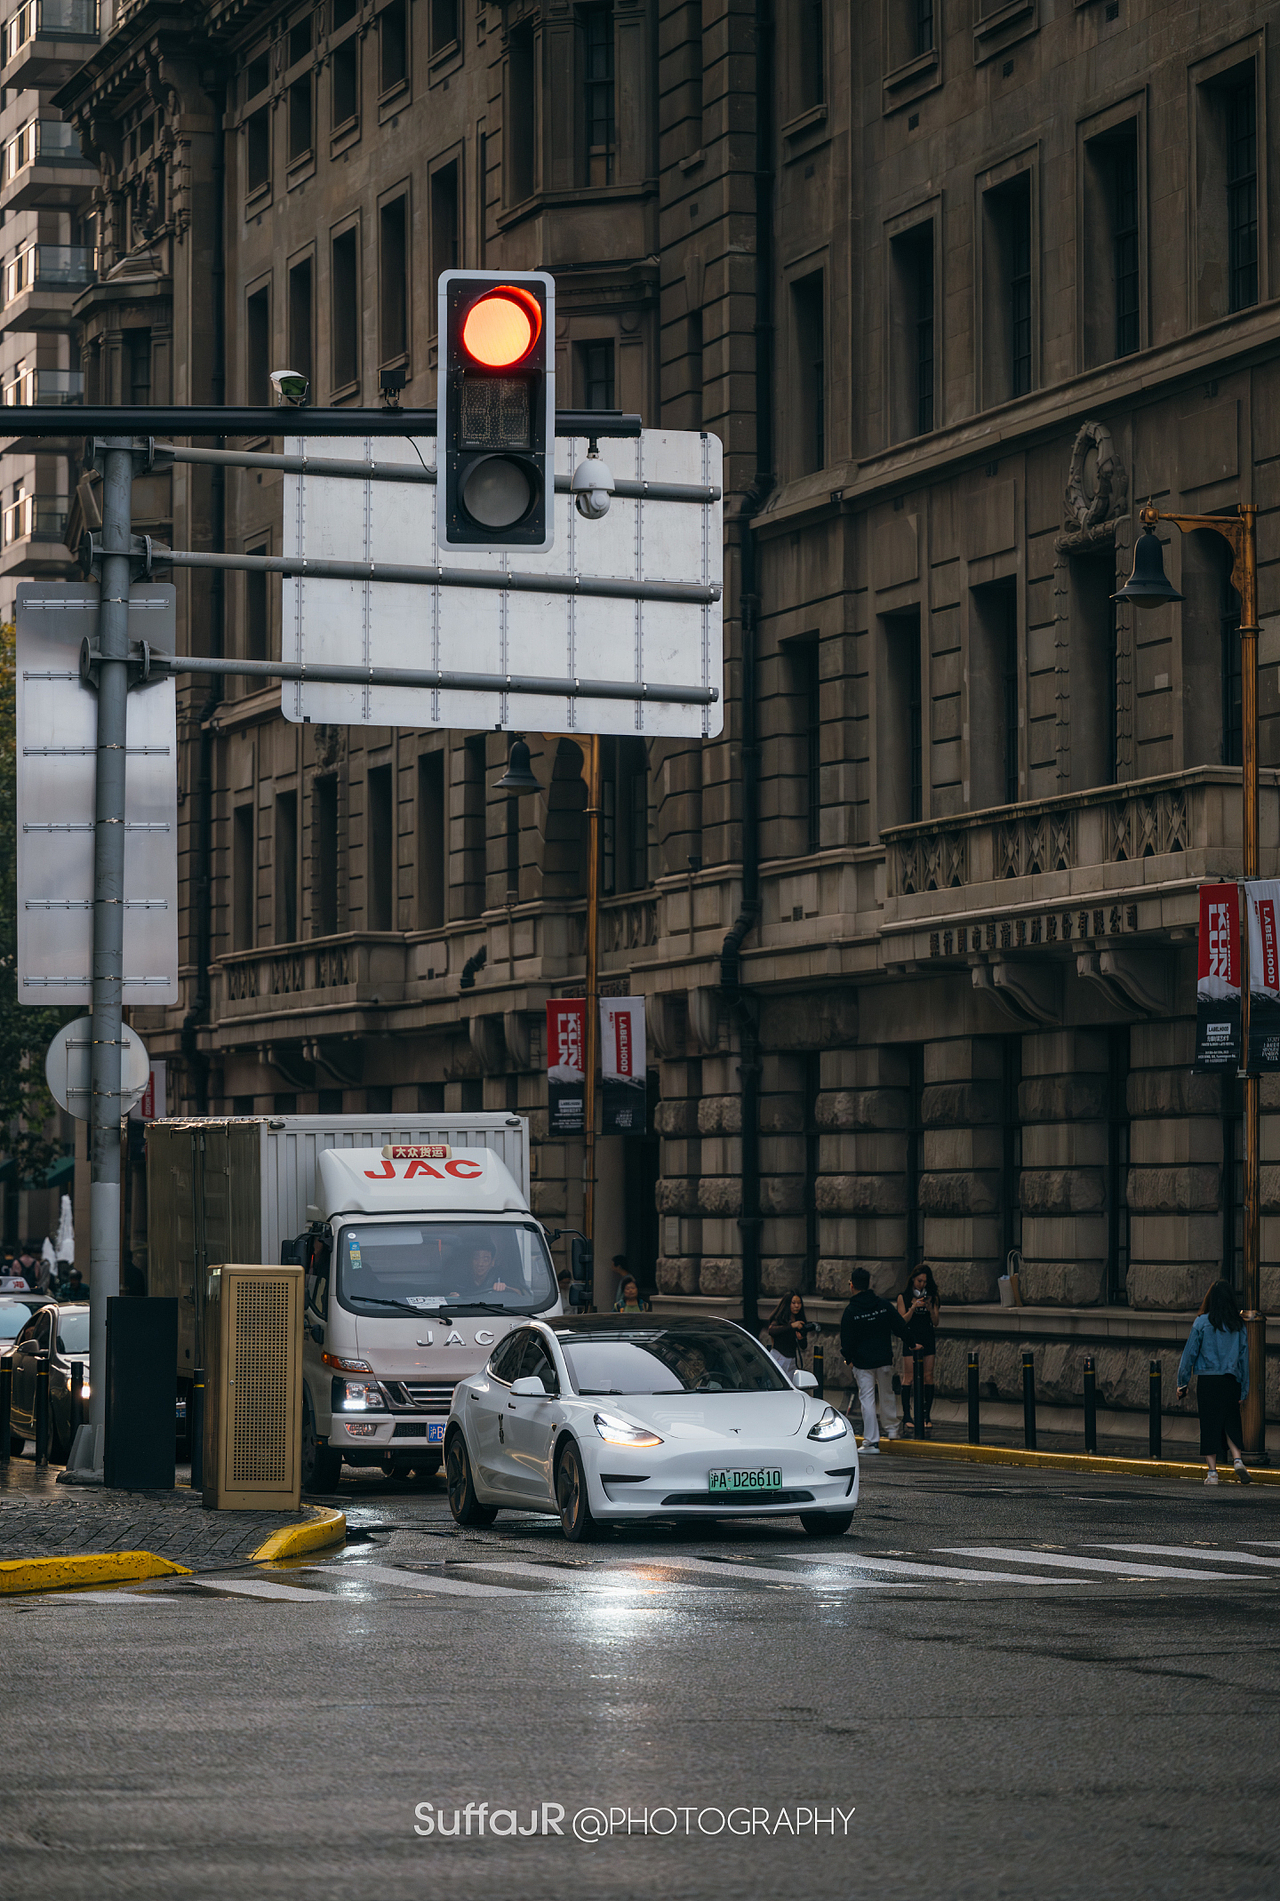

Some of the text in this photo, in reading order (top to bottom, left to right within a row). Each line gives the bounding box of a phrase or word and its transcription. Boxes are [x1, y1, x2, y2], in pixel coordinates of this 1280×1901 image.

[1218, 903, 1228, 981] KUN
[1263, 906, 1275, 985] LABELHOOD
[568, 1013, 578, 1069] KUN
[618, 1015, 629, 1073] LABELHOOD
[364, 1160, 483, 1179] JAC
[395, 1146, 445, 1159] 大众货运
[416, 1330, 495, 1346] JAC
